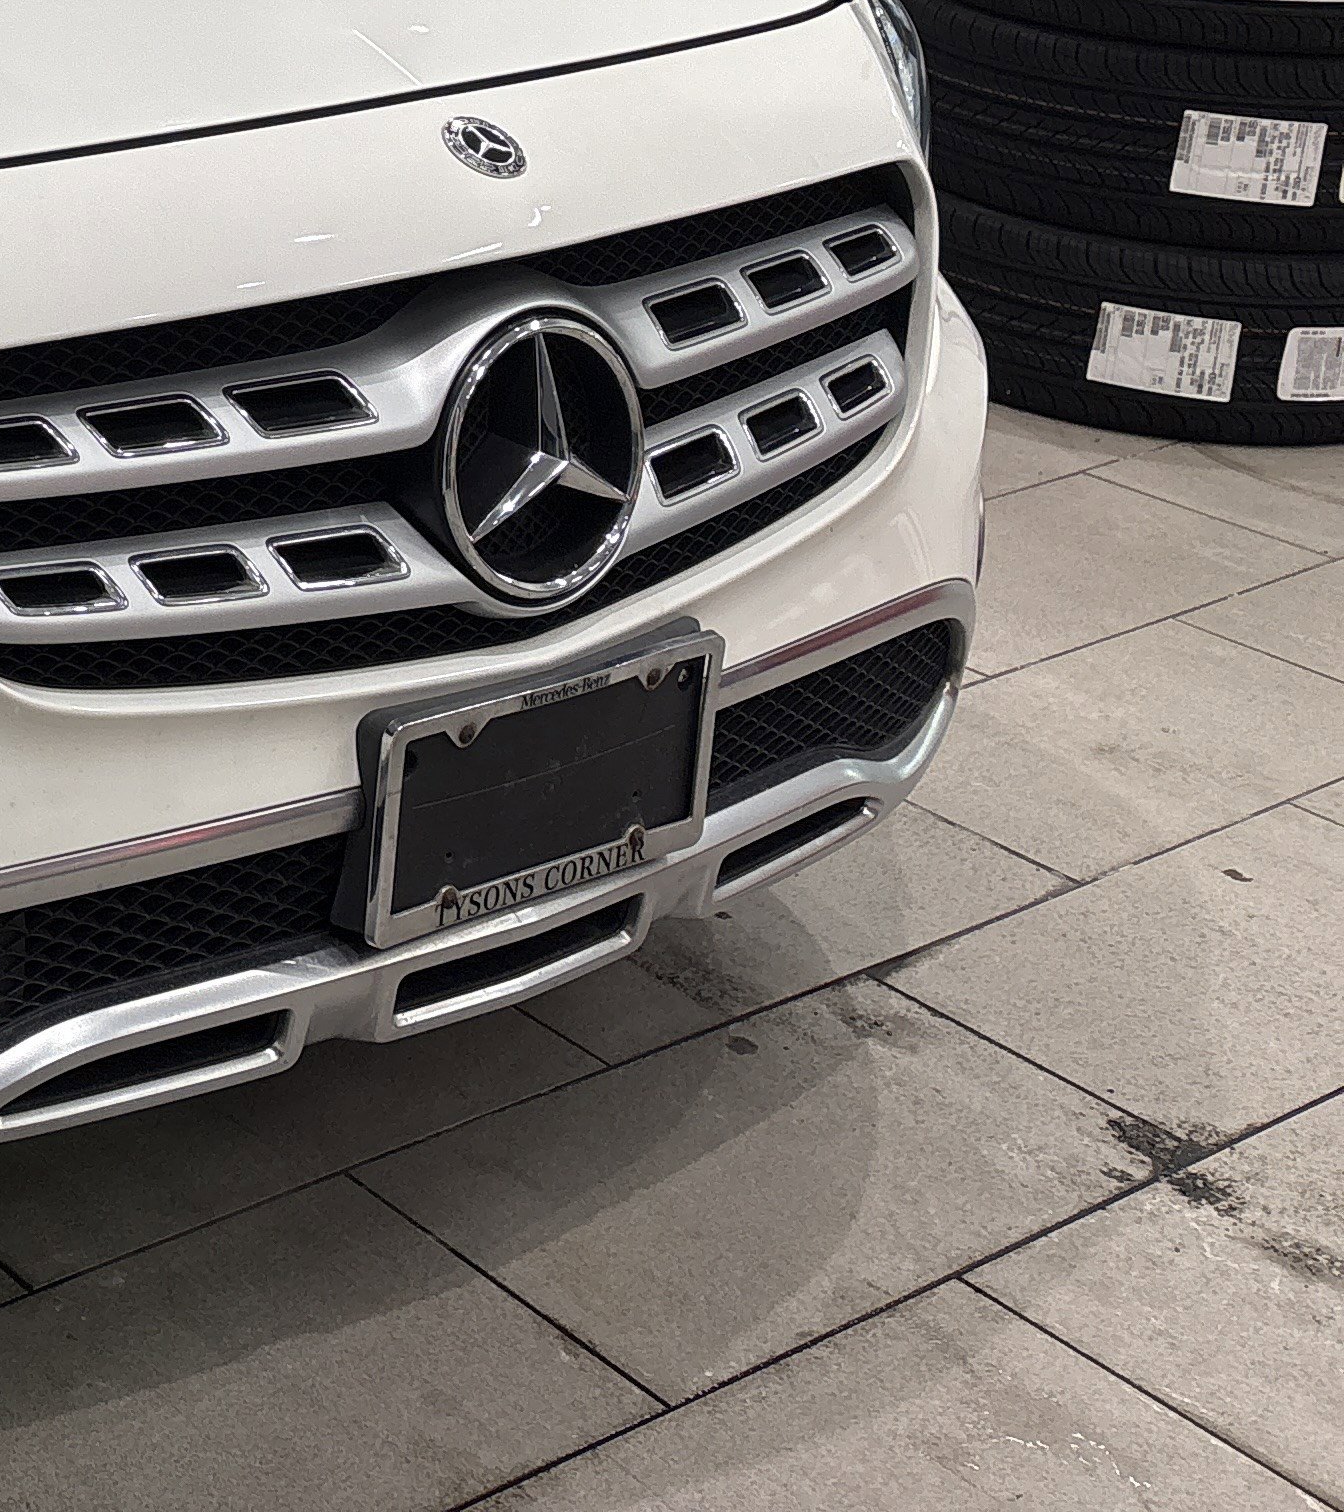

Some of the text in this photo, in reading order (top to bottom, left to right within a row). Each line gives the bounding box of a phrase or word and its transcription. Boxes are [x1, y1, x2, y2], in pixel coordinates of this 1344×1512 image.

[520, 673, 612, 711] Mercedes-Benz
[435, 833, 645, 928] TYSONS CORNER
